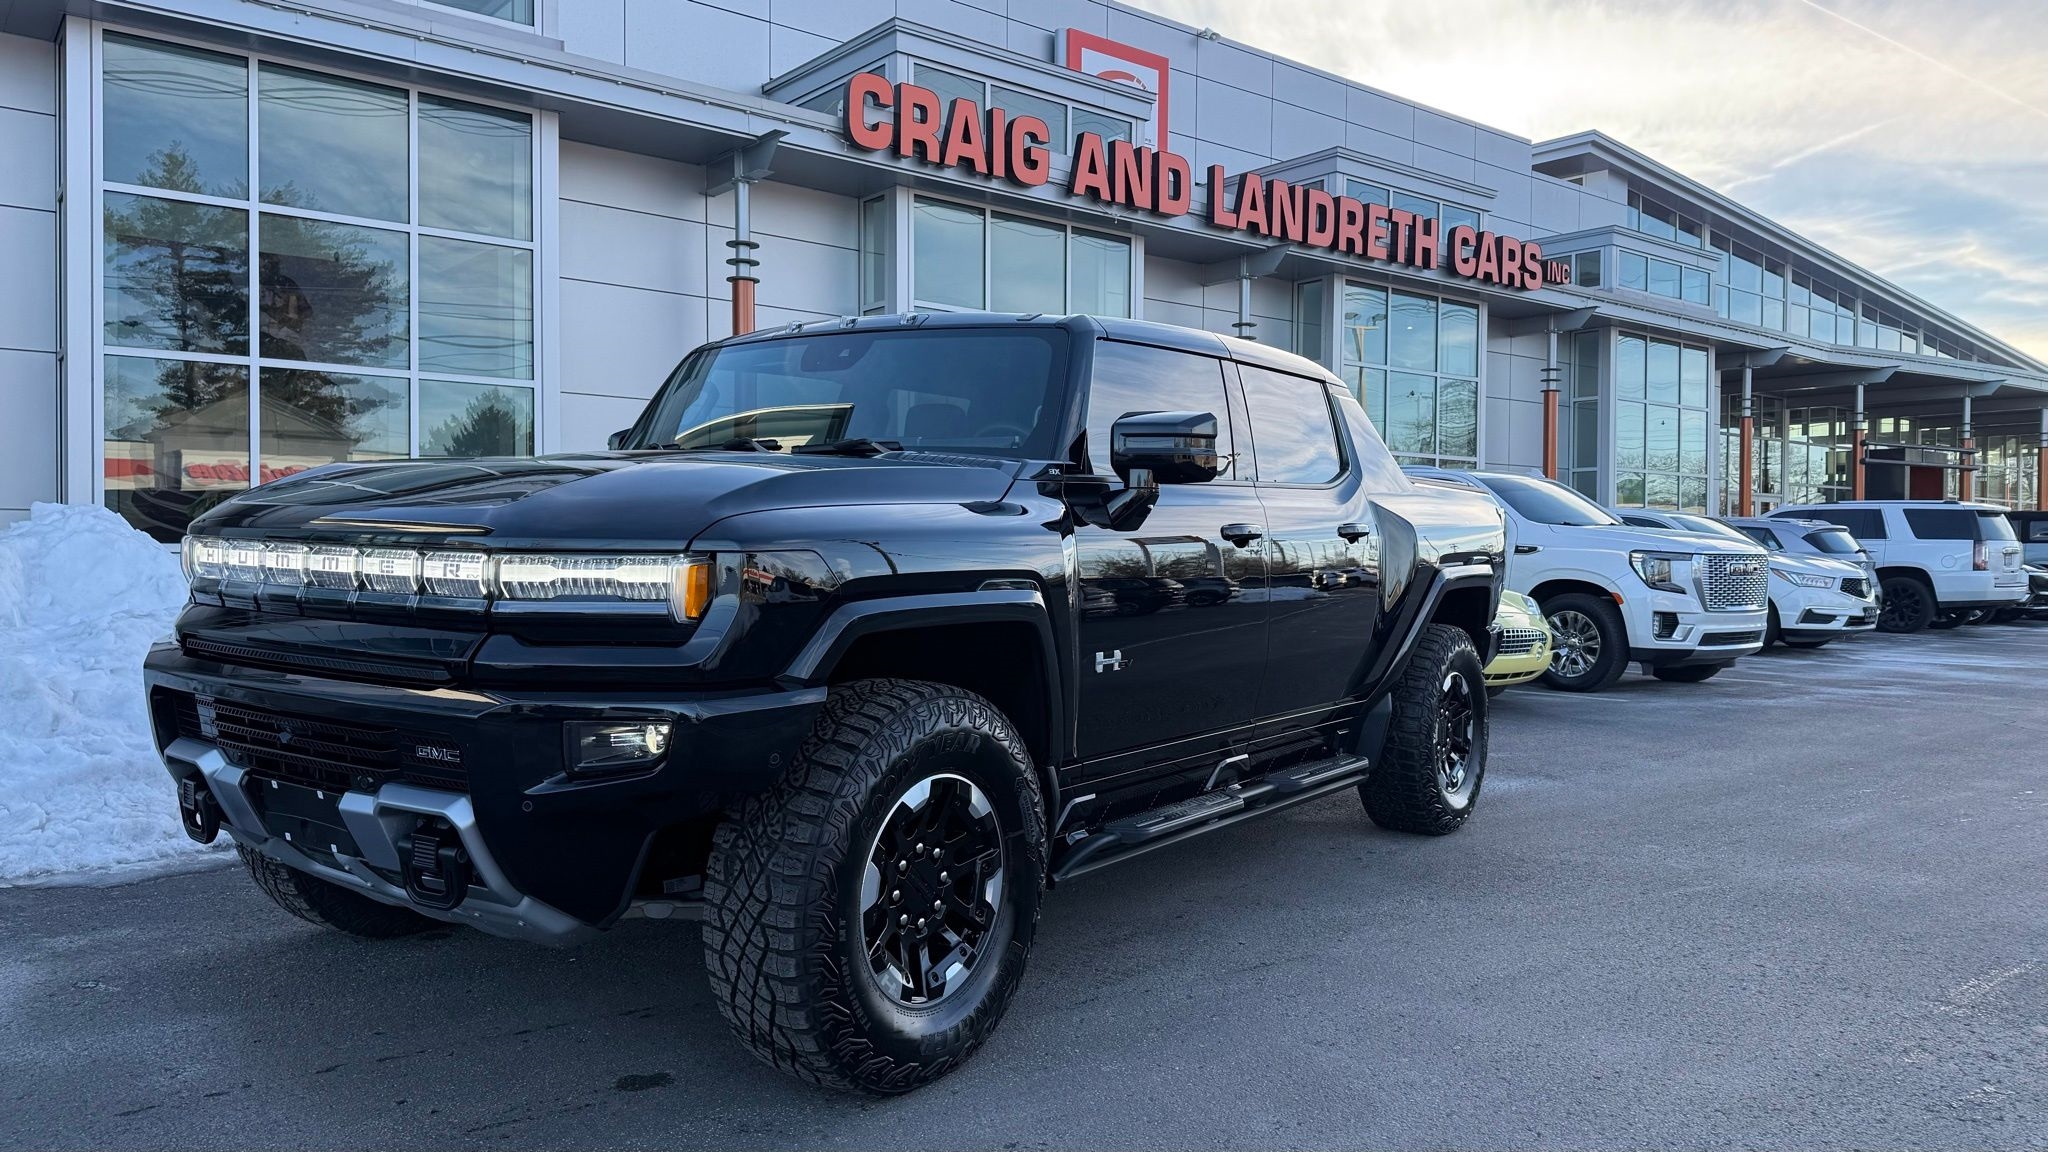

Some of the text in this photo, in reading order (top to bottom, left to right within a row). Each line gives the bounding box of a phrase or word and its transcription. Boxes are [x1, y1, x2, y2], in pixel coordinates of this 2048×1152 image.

[844, 73, 1570, 290] CRAIG AND LANDRETH CARS INC
[206, 550, 460, 578] HUMMER
[1730, 562, 1760, 576] GMC
[416, 745, 460, 762] GMC
[840, 956, 872, 1031] TERRITORY
